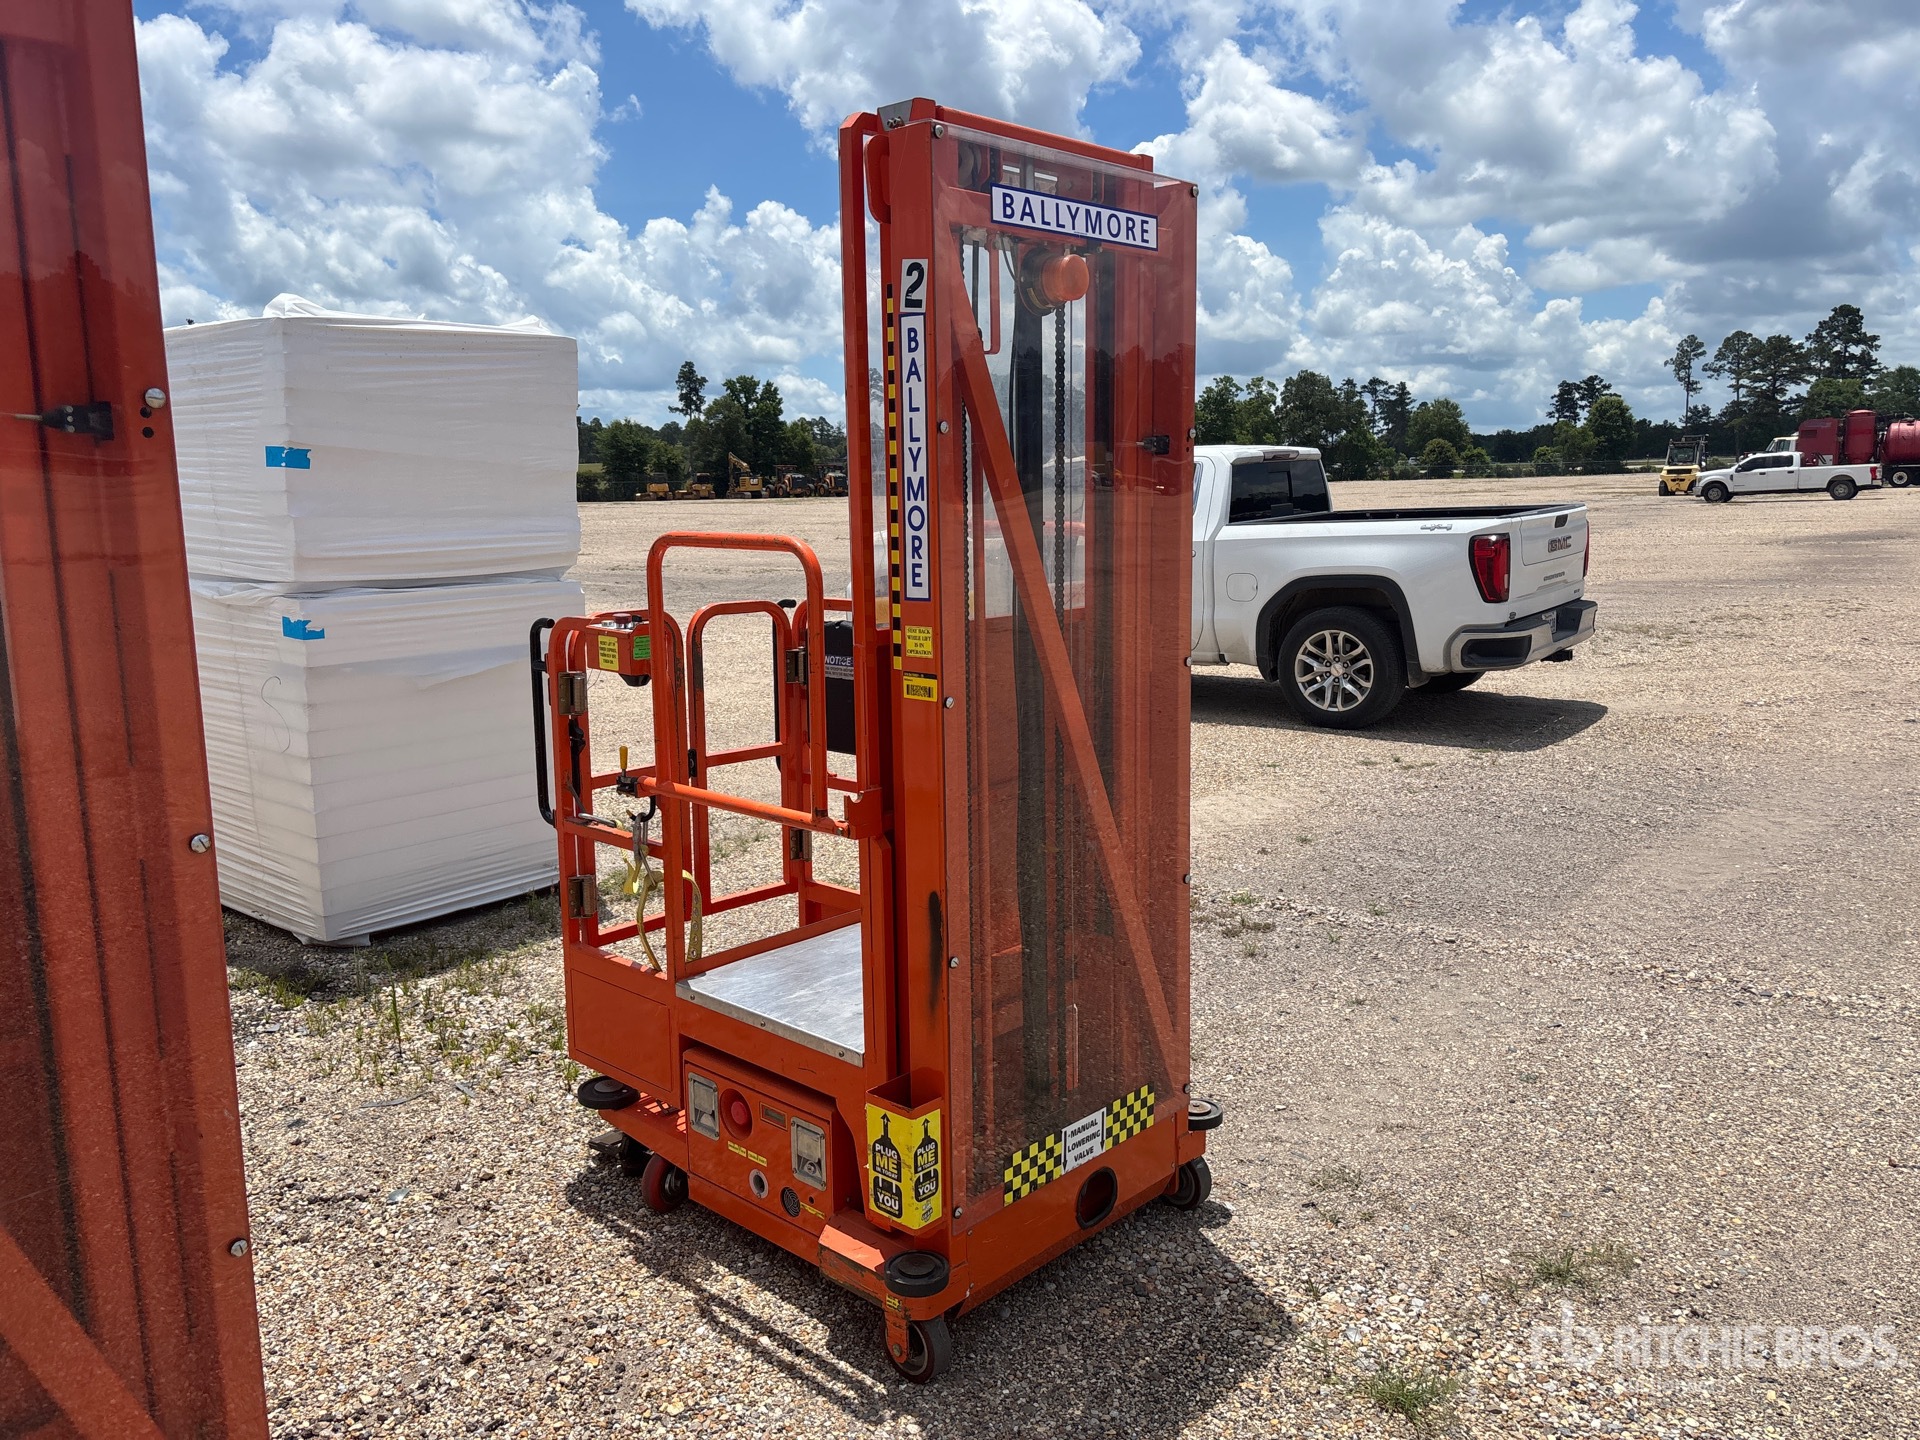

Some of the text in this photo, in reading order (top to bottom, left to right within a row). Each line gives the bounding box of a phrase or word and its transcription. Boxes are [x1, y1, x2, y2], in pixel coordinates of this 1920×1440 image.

[1001, 192, 1150, 244] BALLYMORE
[904, 262, 925, 309] 2
[906, 327, 926, 588] BALLYMORE
[1548, 535, 1571, 553] GMC
[825, 655, 852, 666] NOTICE
[917, 1142, 936, 1156] PLUG
[1067, 1130, 1101, 1153] LOWERING
[875, 1143, 898, 1160] PLUG
[917, 1149, 936, 1167] ME
[1073, 1146, 1095, 1162] VALVE
[875, 1153, 898, 1175] ME
[882, 1168, 898, 1179] TODAY
[918, 1181, 936, 1196] YOU
[877, 1191, 899, 1210] YOU
